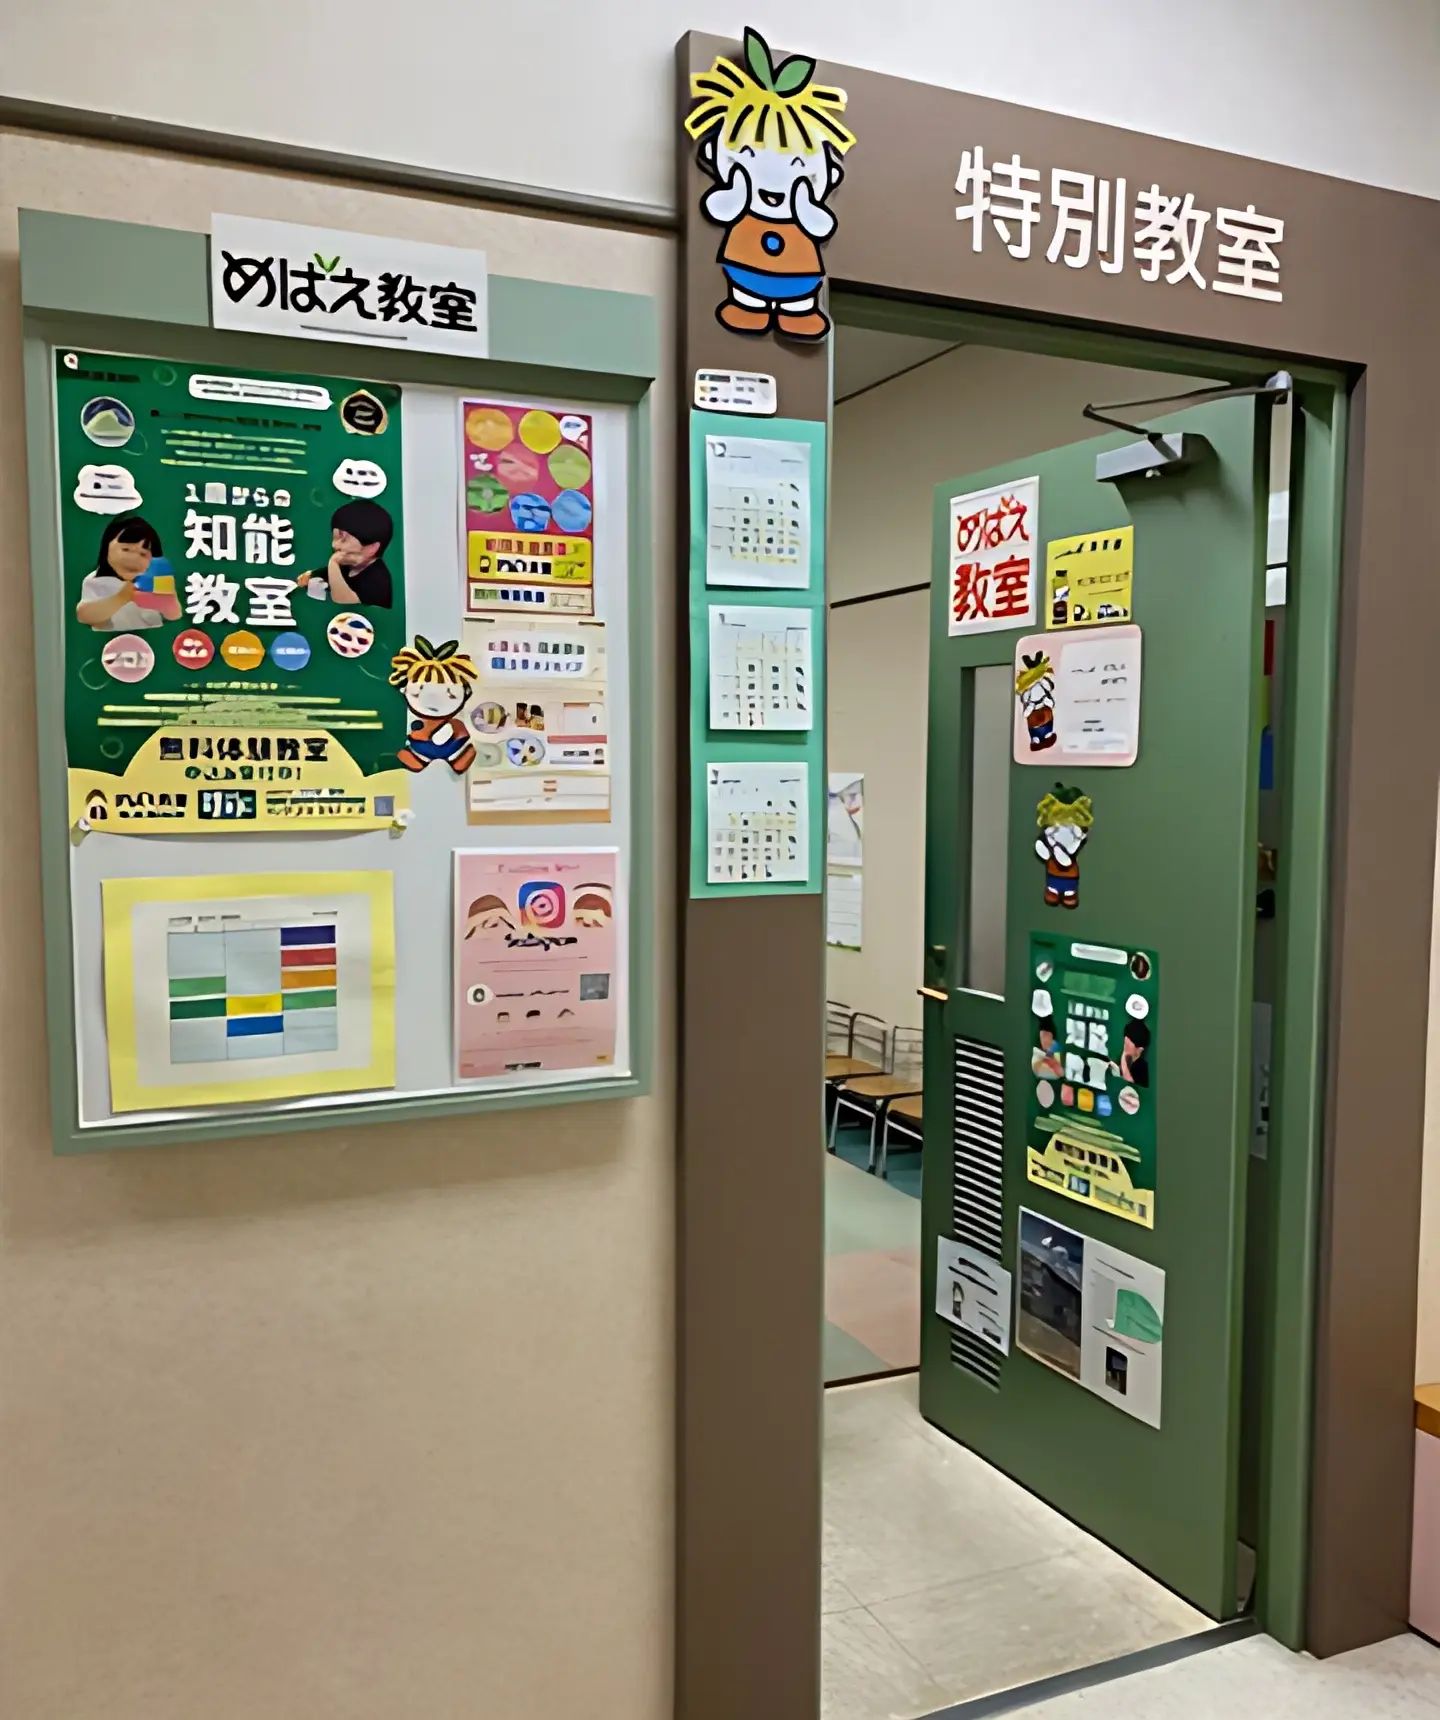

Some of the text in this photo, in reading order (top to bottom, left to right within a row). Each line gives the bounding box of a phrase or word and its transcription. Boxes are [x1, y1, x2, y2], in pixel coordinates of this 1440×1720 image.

[954, 145, 1285, 302] 特別教室
[221, 250, 478, 332] めばえ教室
[183, 508, 296, 566] 知能
[957, 494, 1030, 553] めばえ
[184, 572, 299, 626] 教室
[952, 555, 1031, 622] 教室
